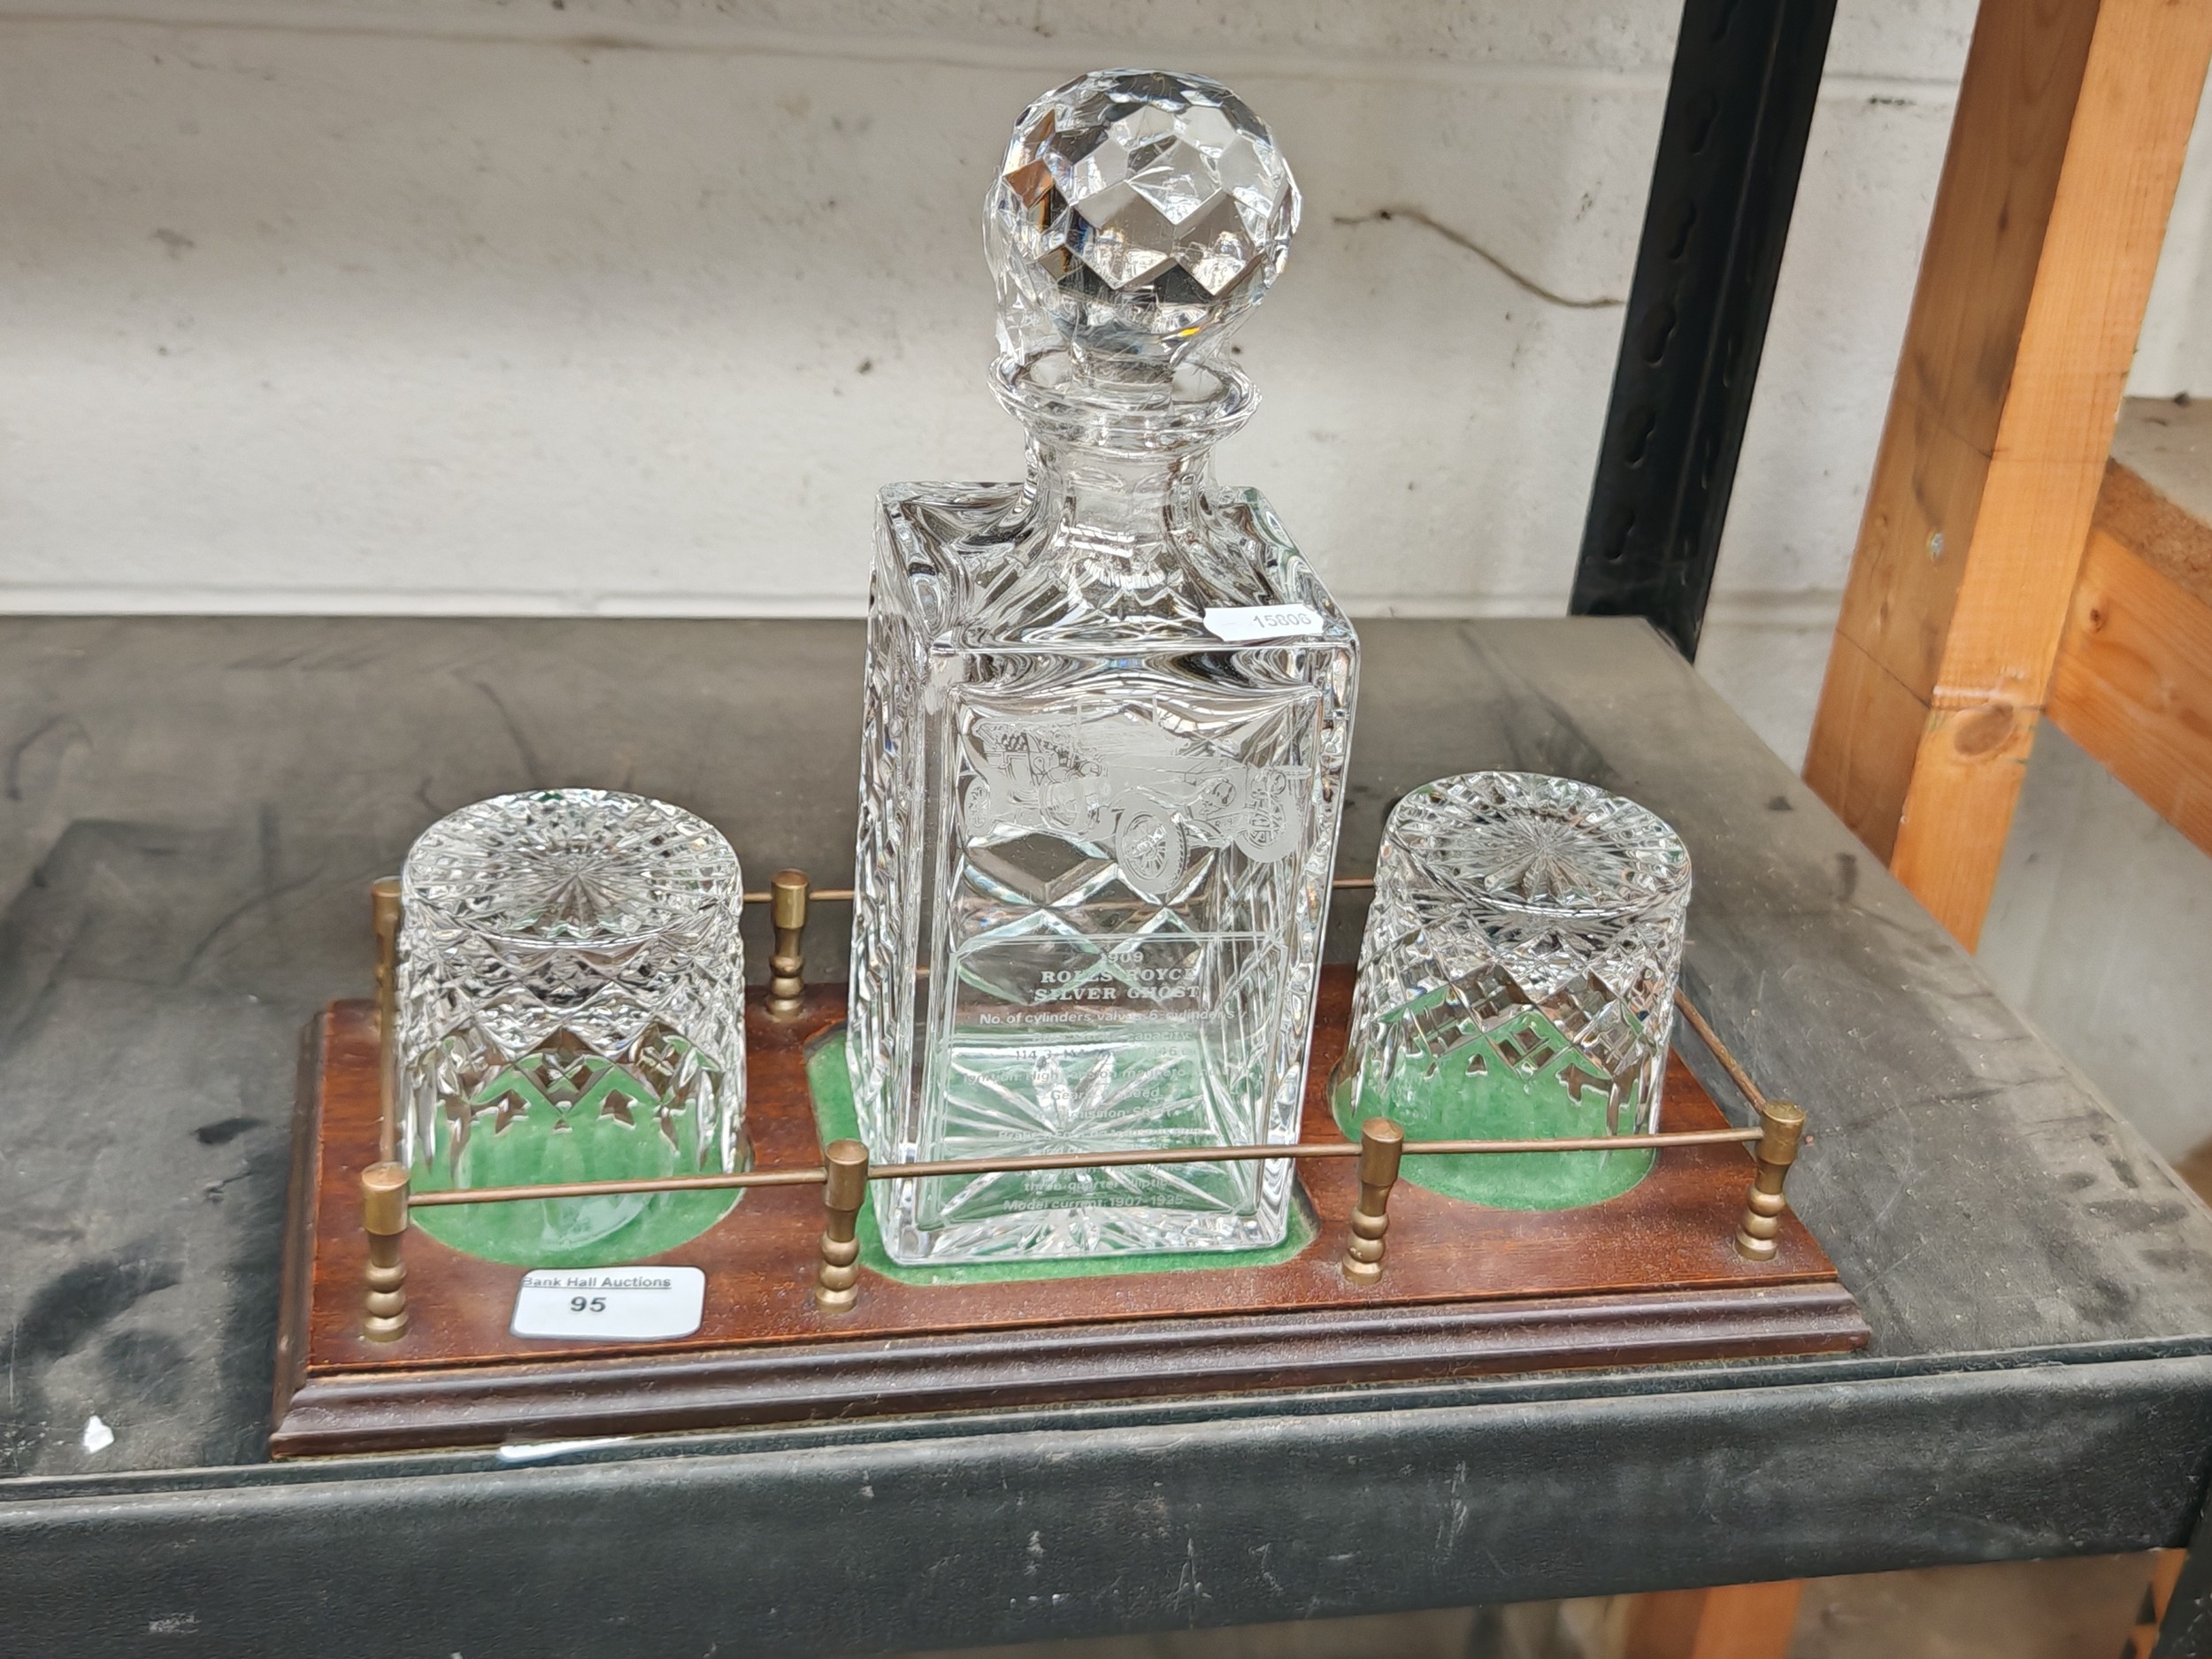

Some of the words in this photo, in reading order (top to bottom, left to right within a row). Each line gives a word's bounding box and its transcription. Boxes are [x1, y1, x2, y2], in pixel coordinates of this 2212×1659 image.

[979, 1013, 1002, 1025] No.
[1006, 1012, 1022, 1024] of
[566, 1277, 597, 1286] Hall
[601, 1277, 672, 1287] Auctions
[570, 1296, 606, 1312] 95
